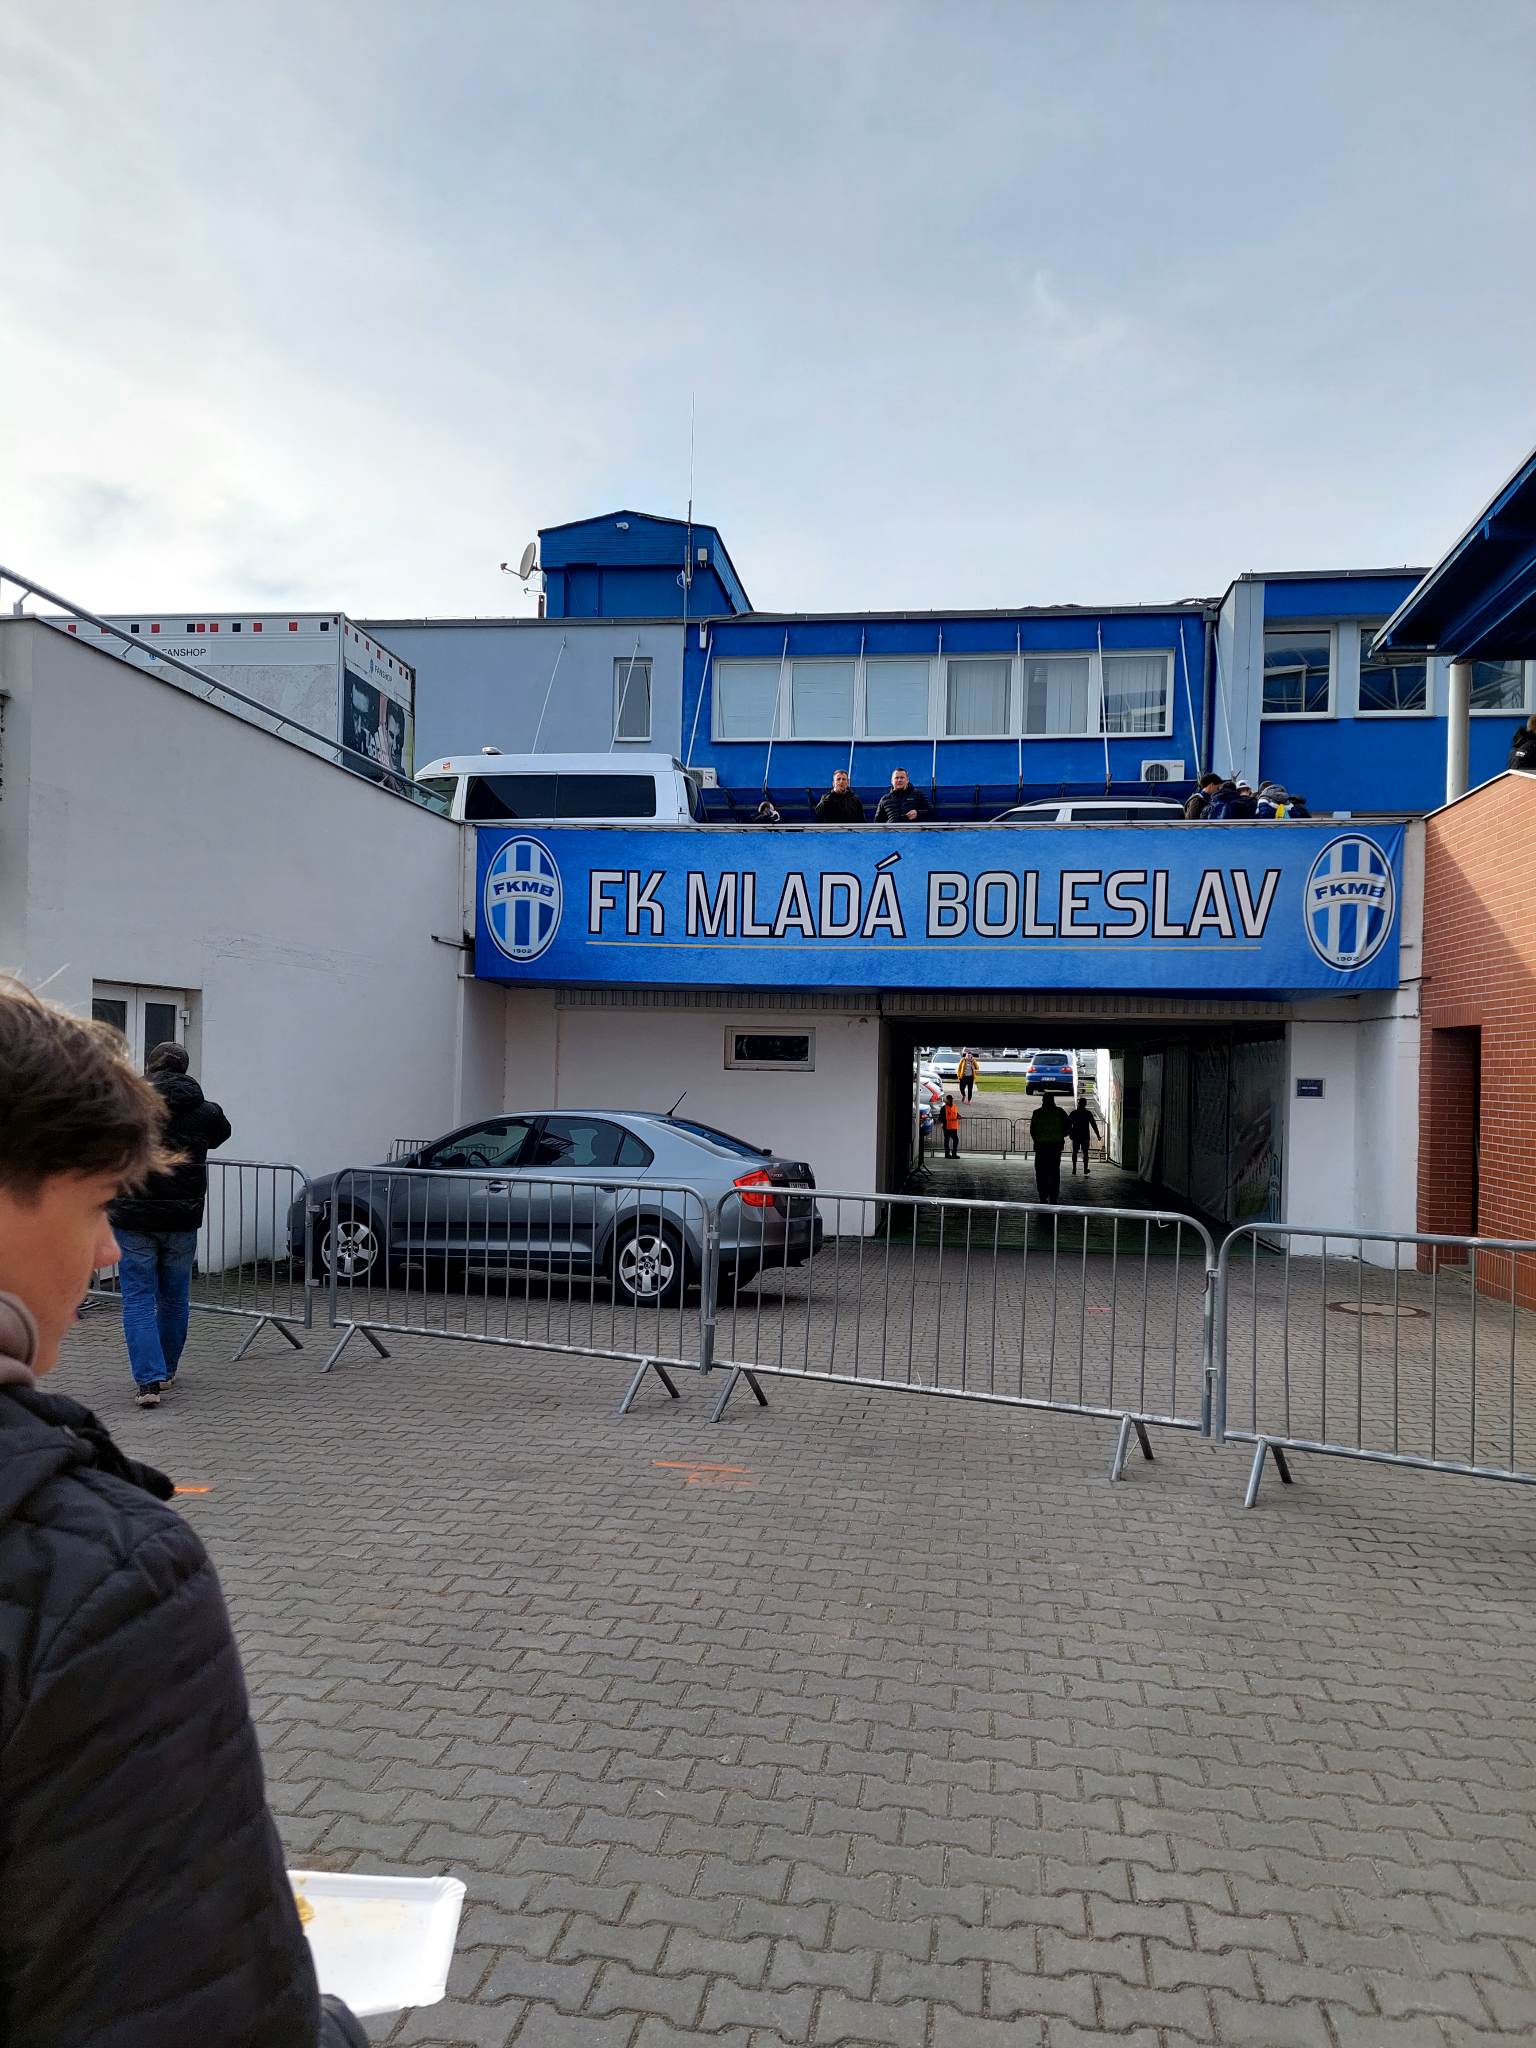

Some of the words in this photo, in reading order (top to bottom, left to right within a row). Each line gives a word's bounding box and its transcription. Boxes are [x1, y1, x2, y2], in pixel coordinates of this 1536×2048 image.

[493, 880, 555, 897] FKMB
[588, 868, 667, 936] FK
[686, 850, 907, 939] MLADÁ
[926, 867, 1283, 939] BOLESLAV
[1314, 882, 1386, 900] FKMB
